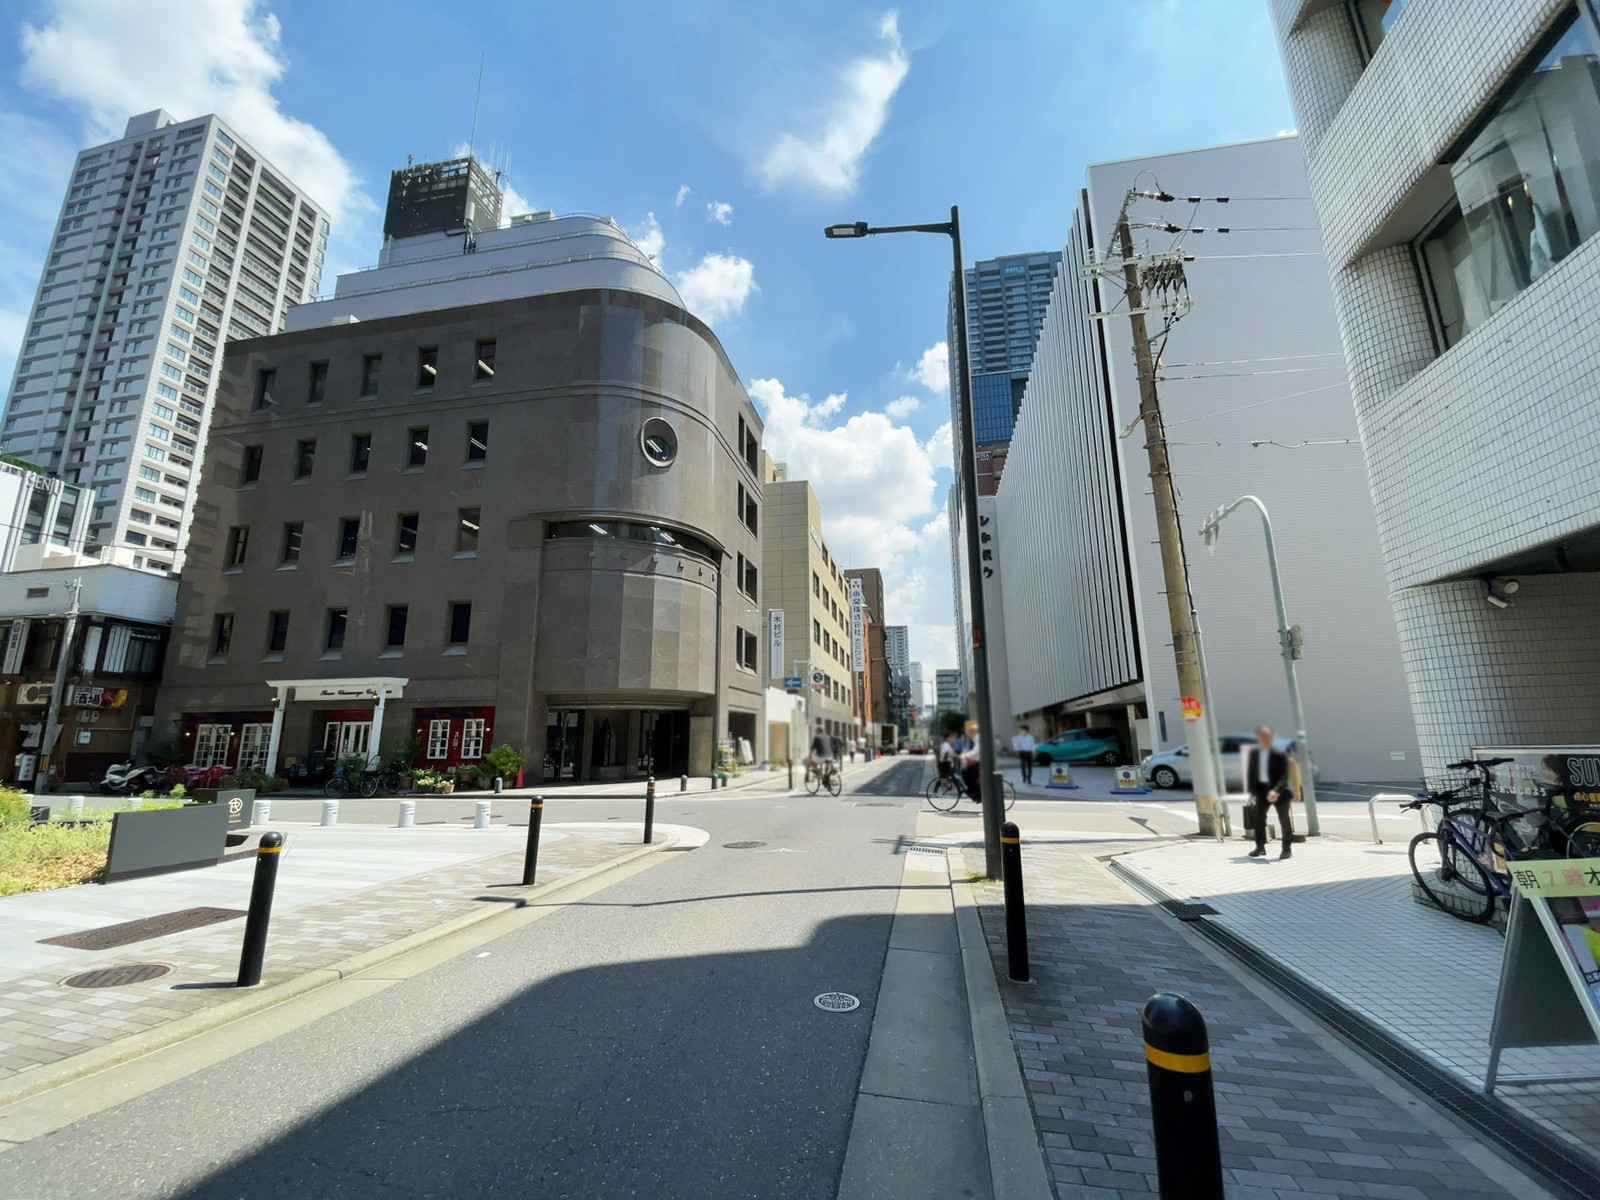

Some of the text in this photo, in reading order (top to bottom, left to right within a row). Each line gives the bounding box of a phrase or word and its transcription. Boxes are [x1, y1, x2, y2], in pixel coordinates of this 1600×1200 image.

[773, 616, 782, 647] 木村ビル
[73, 692, 102, 707] 酒場
